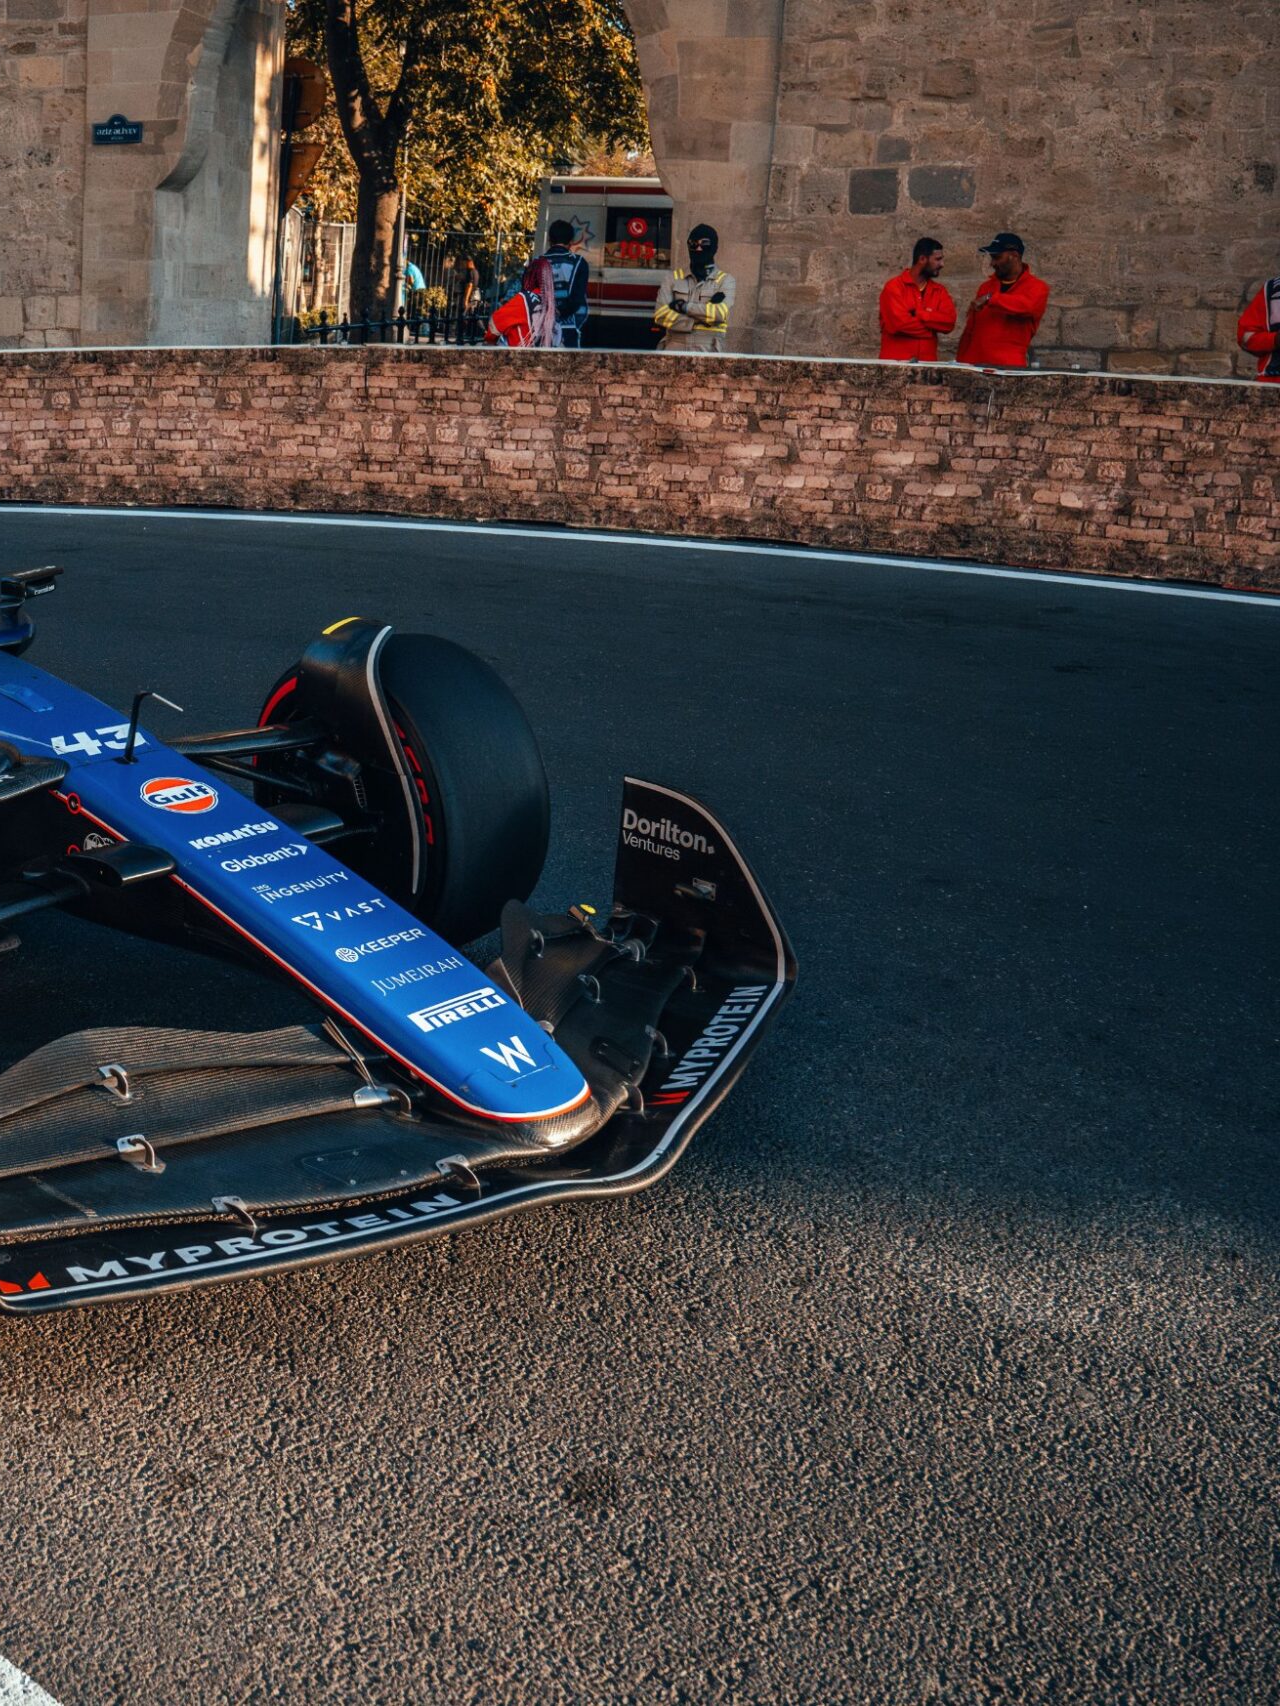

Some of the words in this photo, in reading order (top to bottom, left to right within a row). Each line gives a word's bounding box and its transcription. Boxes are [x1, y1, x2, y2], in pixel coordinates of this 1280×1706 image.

[51, 723, 147, 756] 43
[148, 785, 210, 805] Gulf
[188, 821, 279, 850] KOMATSU
[622, 830, 680, 860] Ventures
[220, 846, 299, 873] Globant
[260, 871, 348, 904] INGENUITY
[325, 898, 386, 921] VAST
[355, 927, 426, 956] KEEPER
[370, 956, 464, 997] JUMEIRAH
[406, 986, 507, 1033] PIRELLI
[660, 985, 768, 1091] MYPROTEIN
[66, 1193, 463, 1283] MYPROTEIN
